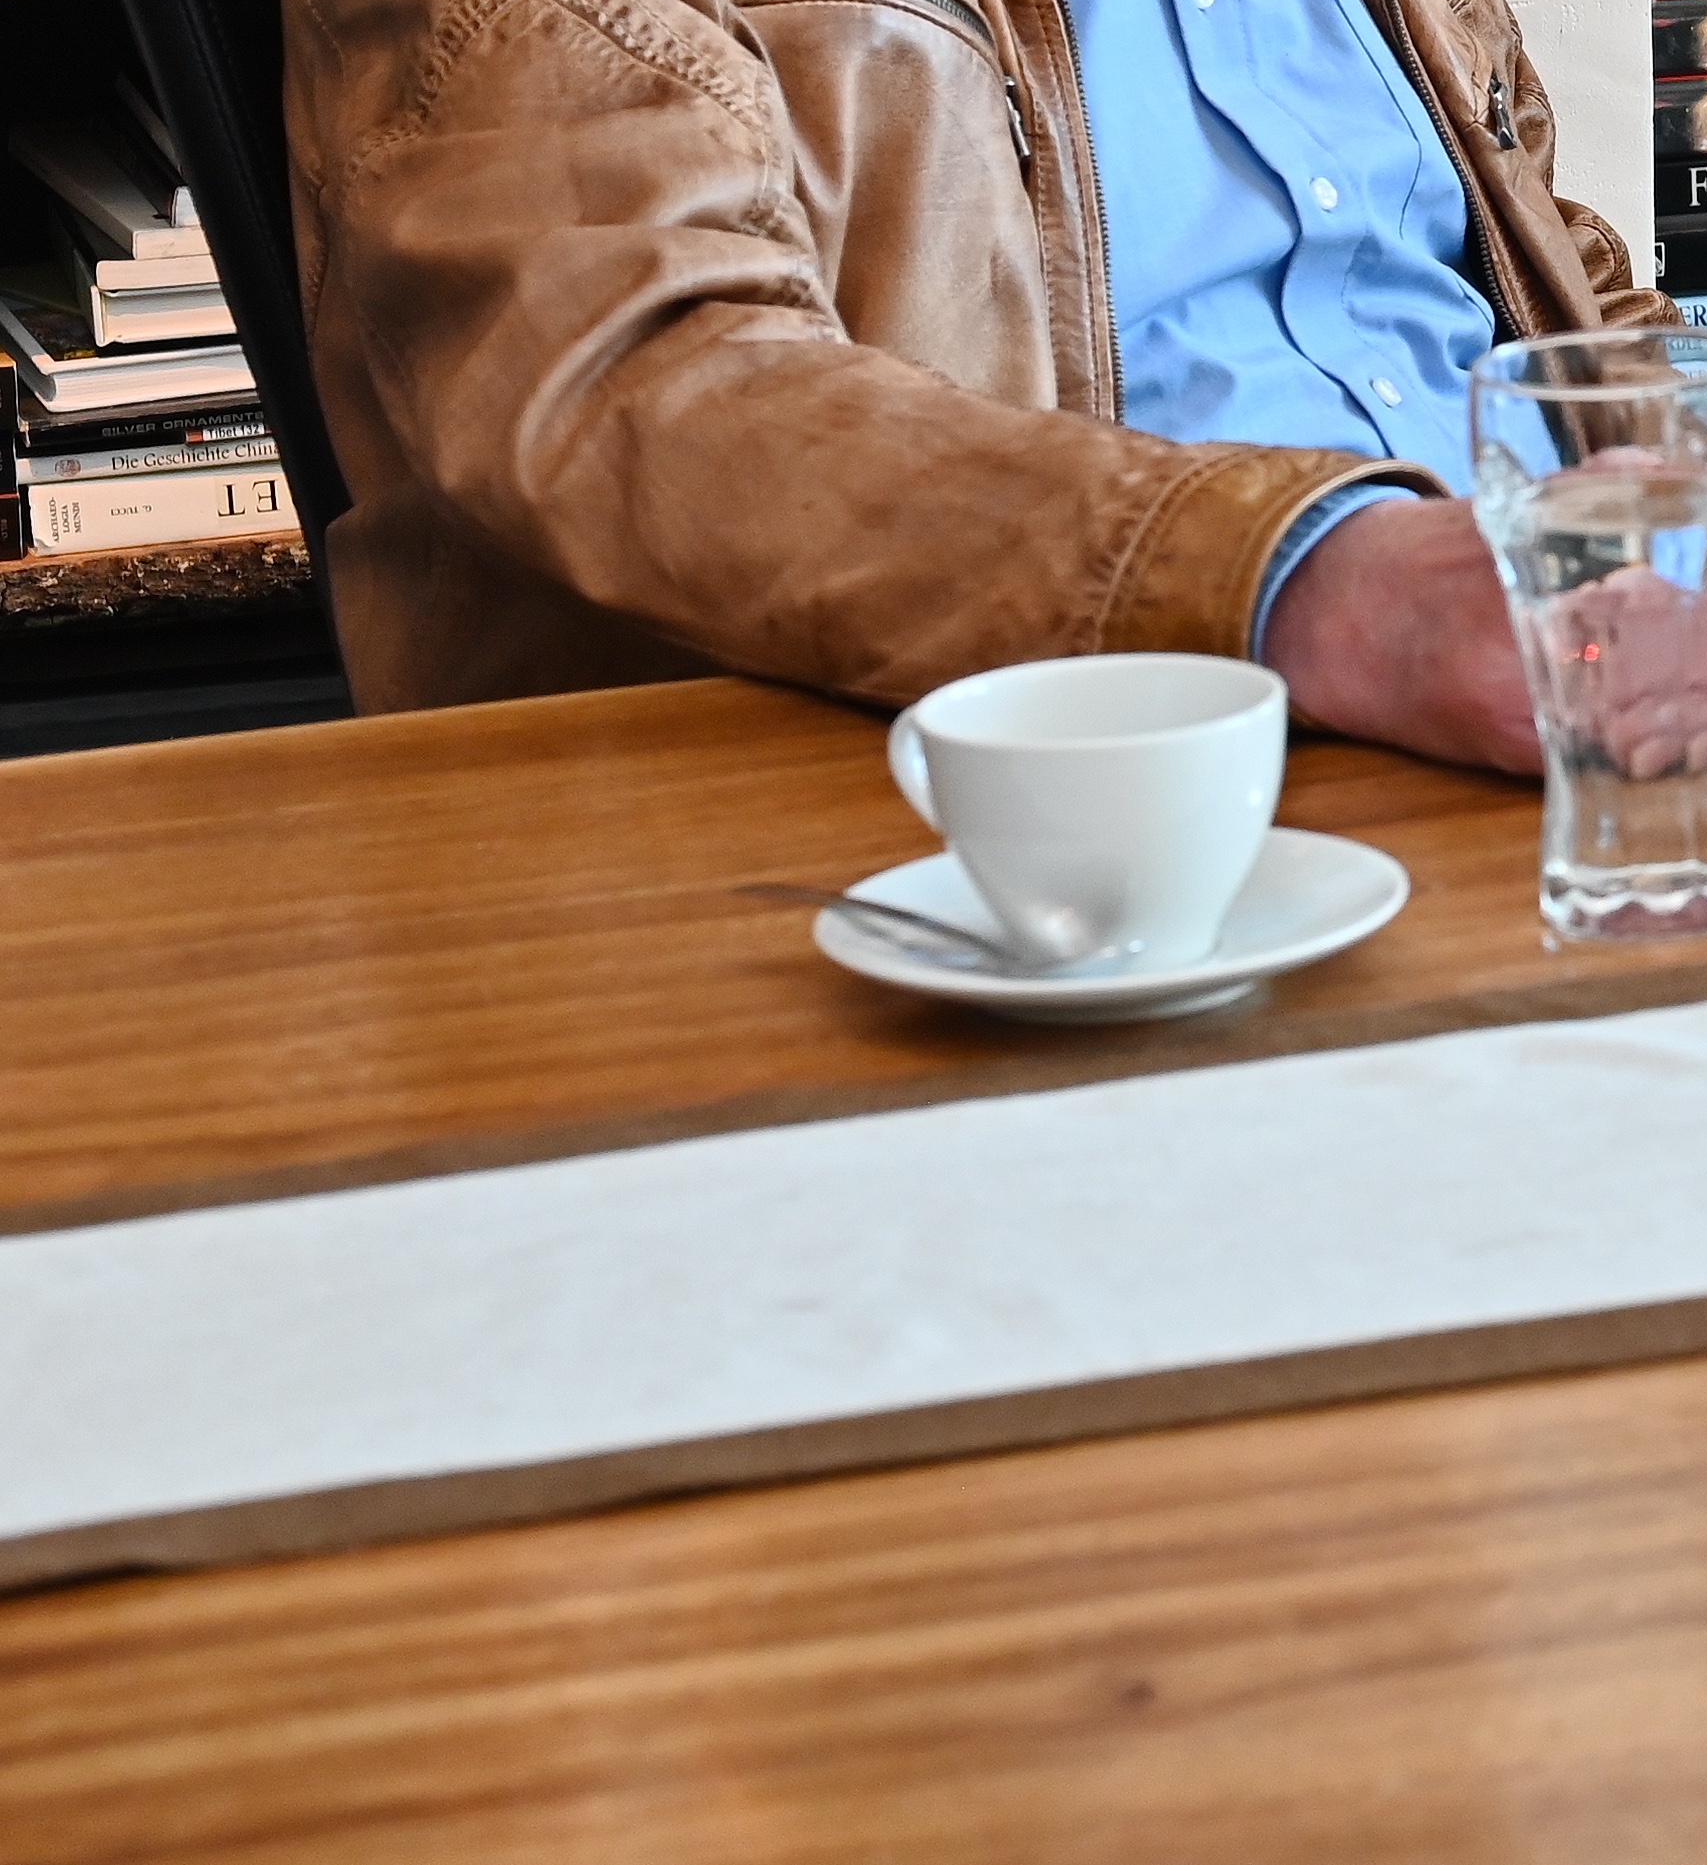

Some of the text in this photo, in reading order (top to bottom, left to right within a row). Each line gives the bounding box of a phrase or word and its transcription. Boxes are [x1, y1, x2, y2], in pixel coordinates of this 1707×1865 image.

[162, 411, 264, 430] ORNAMENTS
[111, 446, 229, 471] Die Geschichte
[110, 506, 139, 517] TUCCI
